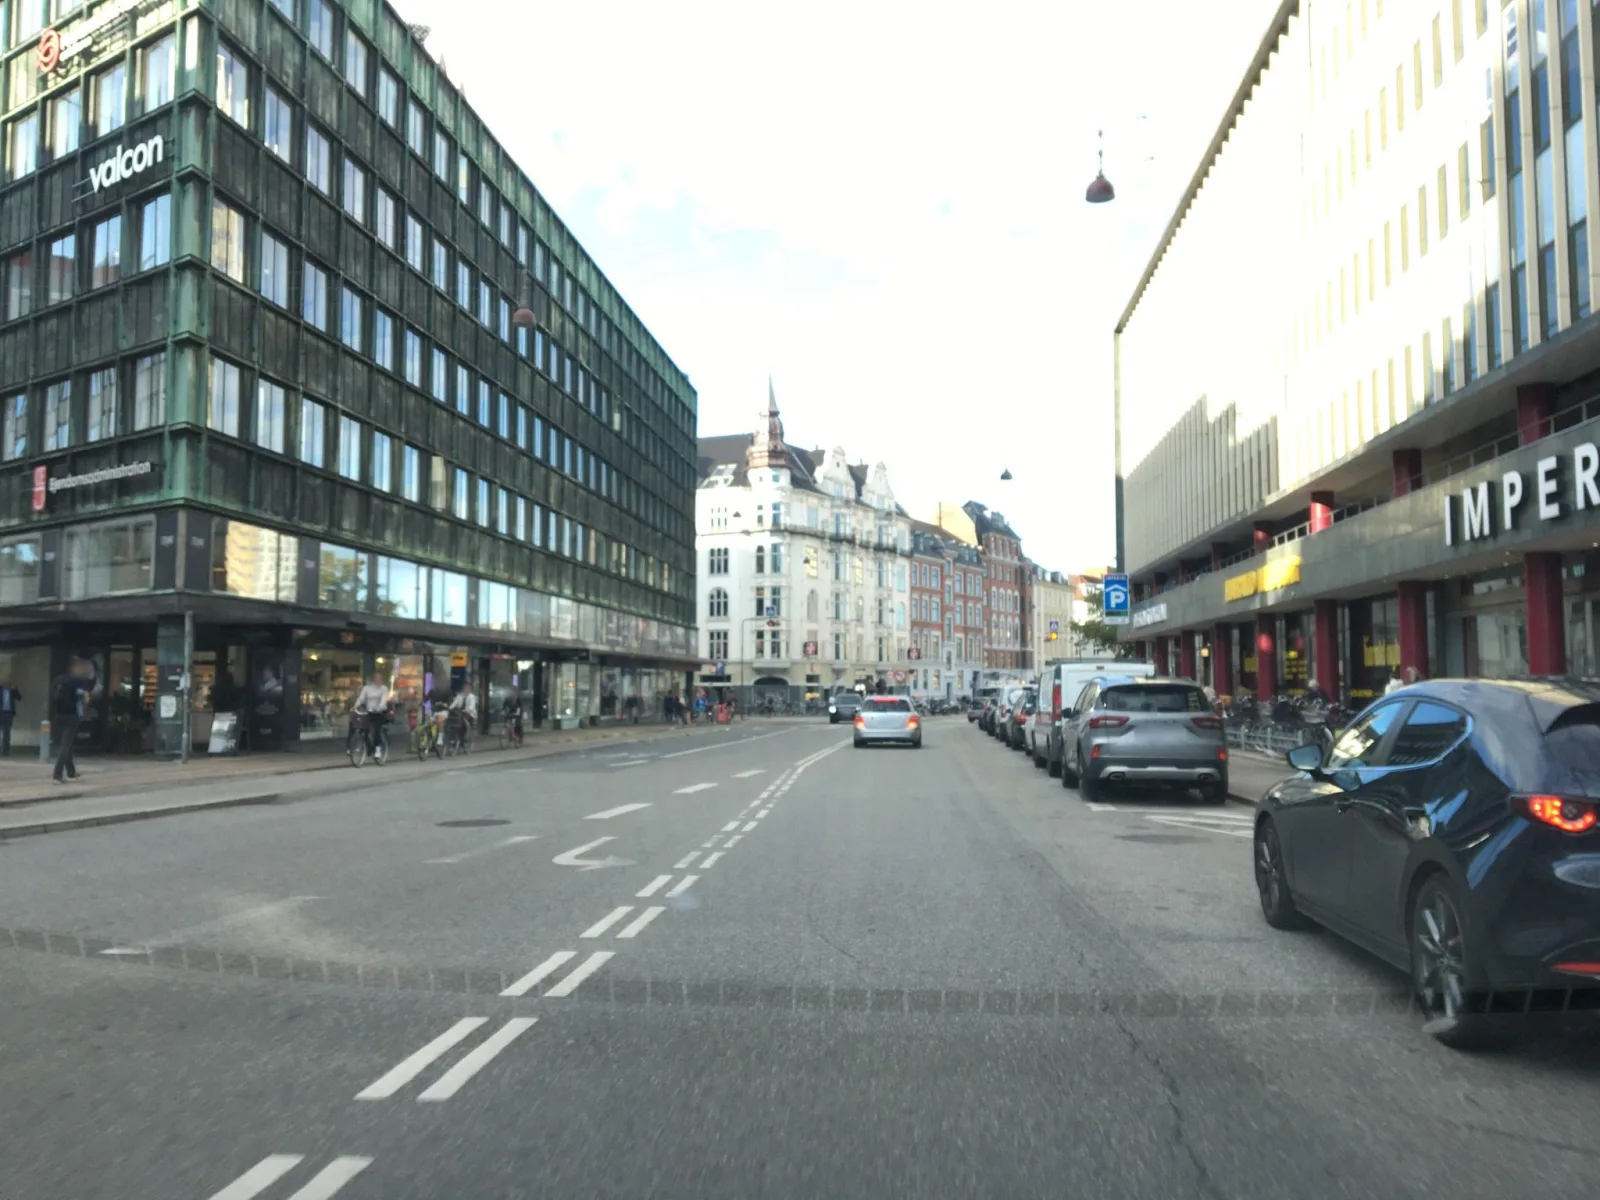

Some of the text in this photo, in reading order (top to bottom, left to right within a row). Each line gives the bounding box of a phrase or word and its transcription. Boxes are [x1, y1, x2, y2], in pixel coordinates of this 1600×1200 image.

[89, 134, 163, 193] valcon
[1444, 442, 1600, 546] IMPER
[1110, 591, 1126, 608] P
